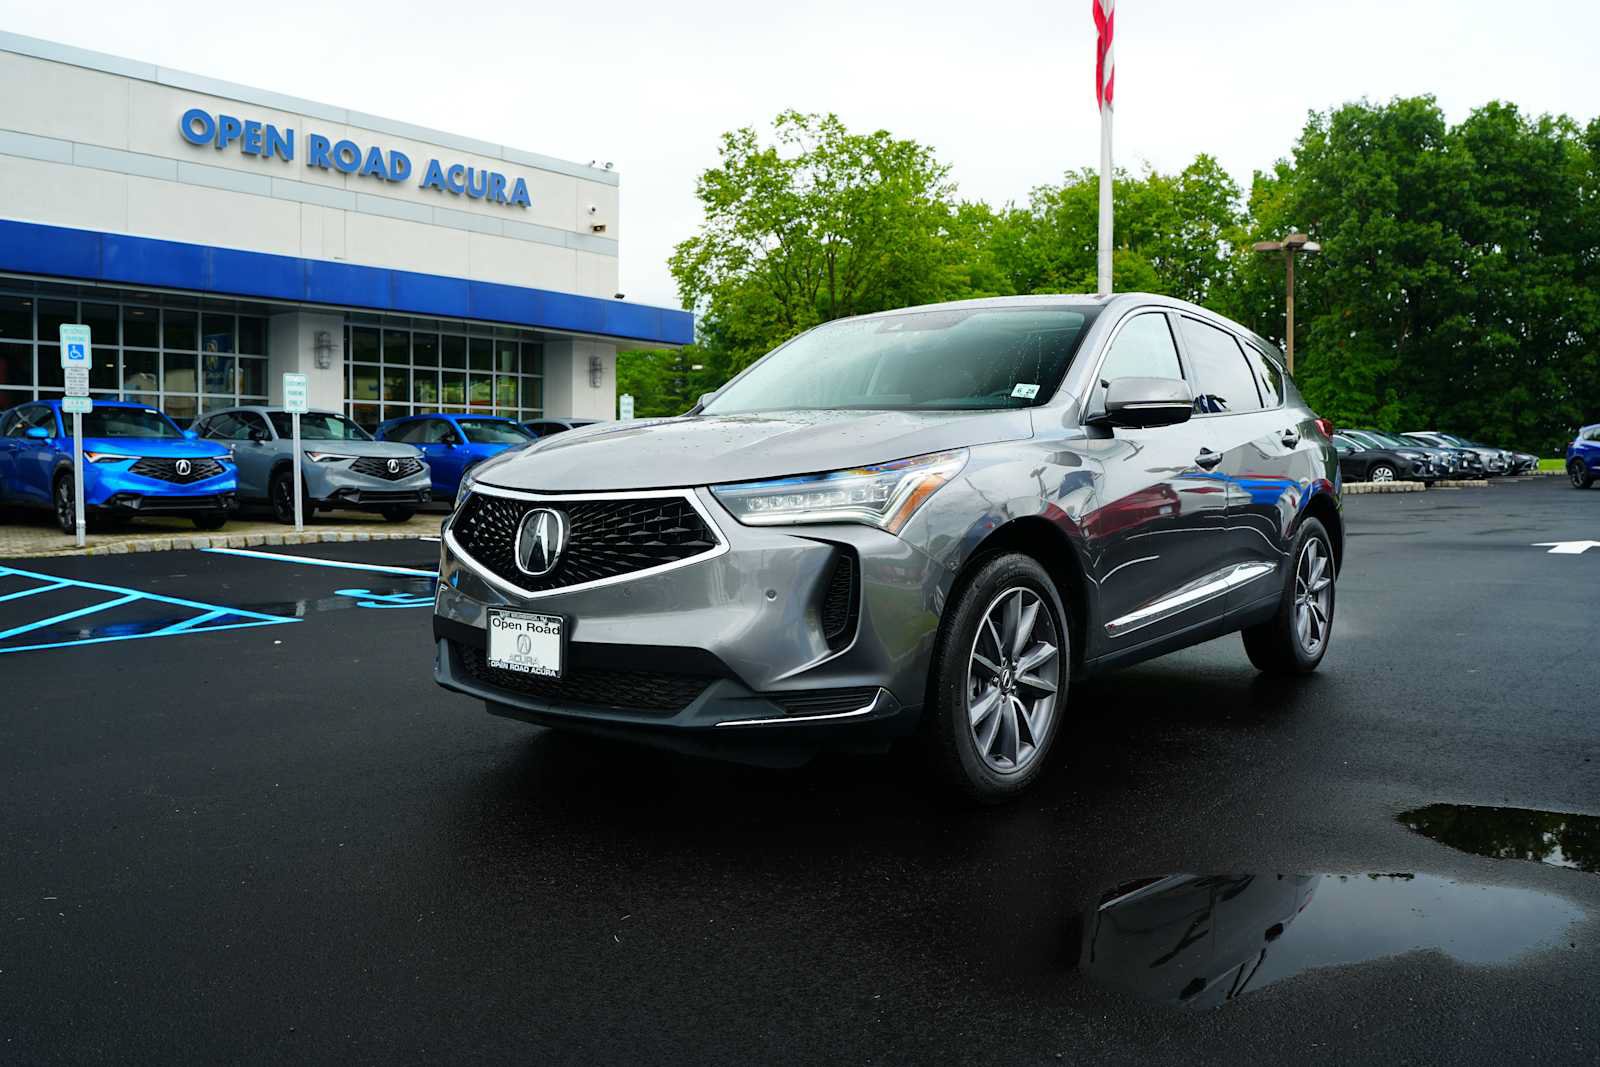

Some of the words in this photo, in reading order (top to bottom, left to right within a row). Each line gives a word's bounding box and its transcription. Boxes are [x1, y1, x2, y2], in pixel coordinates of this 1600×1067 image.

[179, 108, 294, 162] OPEN
[306, 133, 412, 182] ROAD
[419, 158, 532, 208] ACURA
[492, 618, 521, 631] Open
[527, 622, 561, 635] Road
[490, 660, 509, 670] OPEN
[509, 663, 530, 673] ROAD
[530, 667, 556, 677] ACURA
